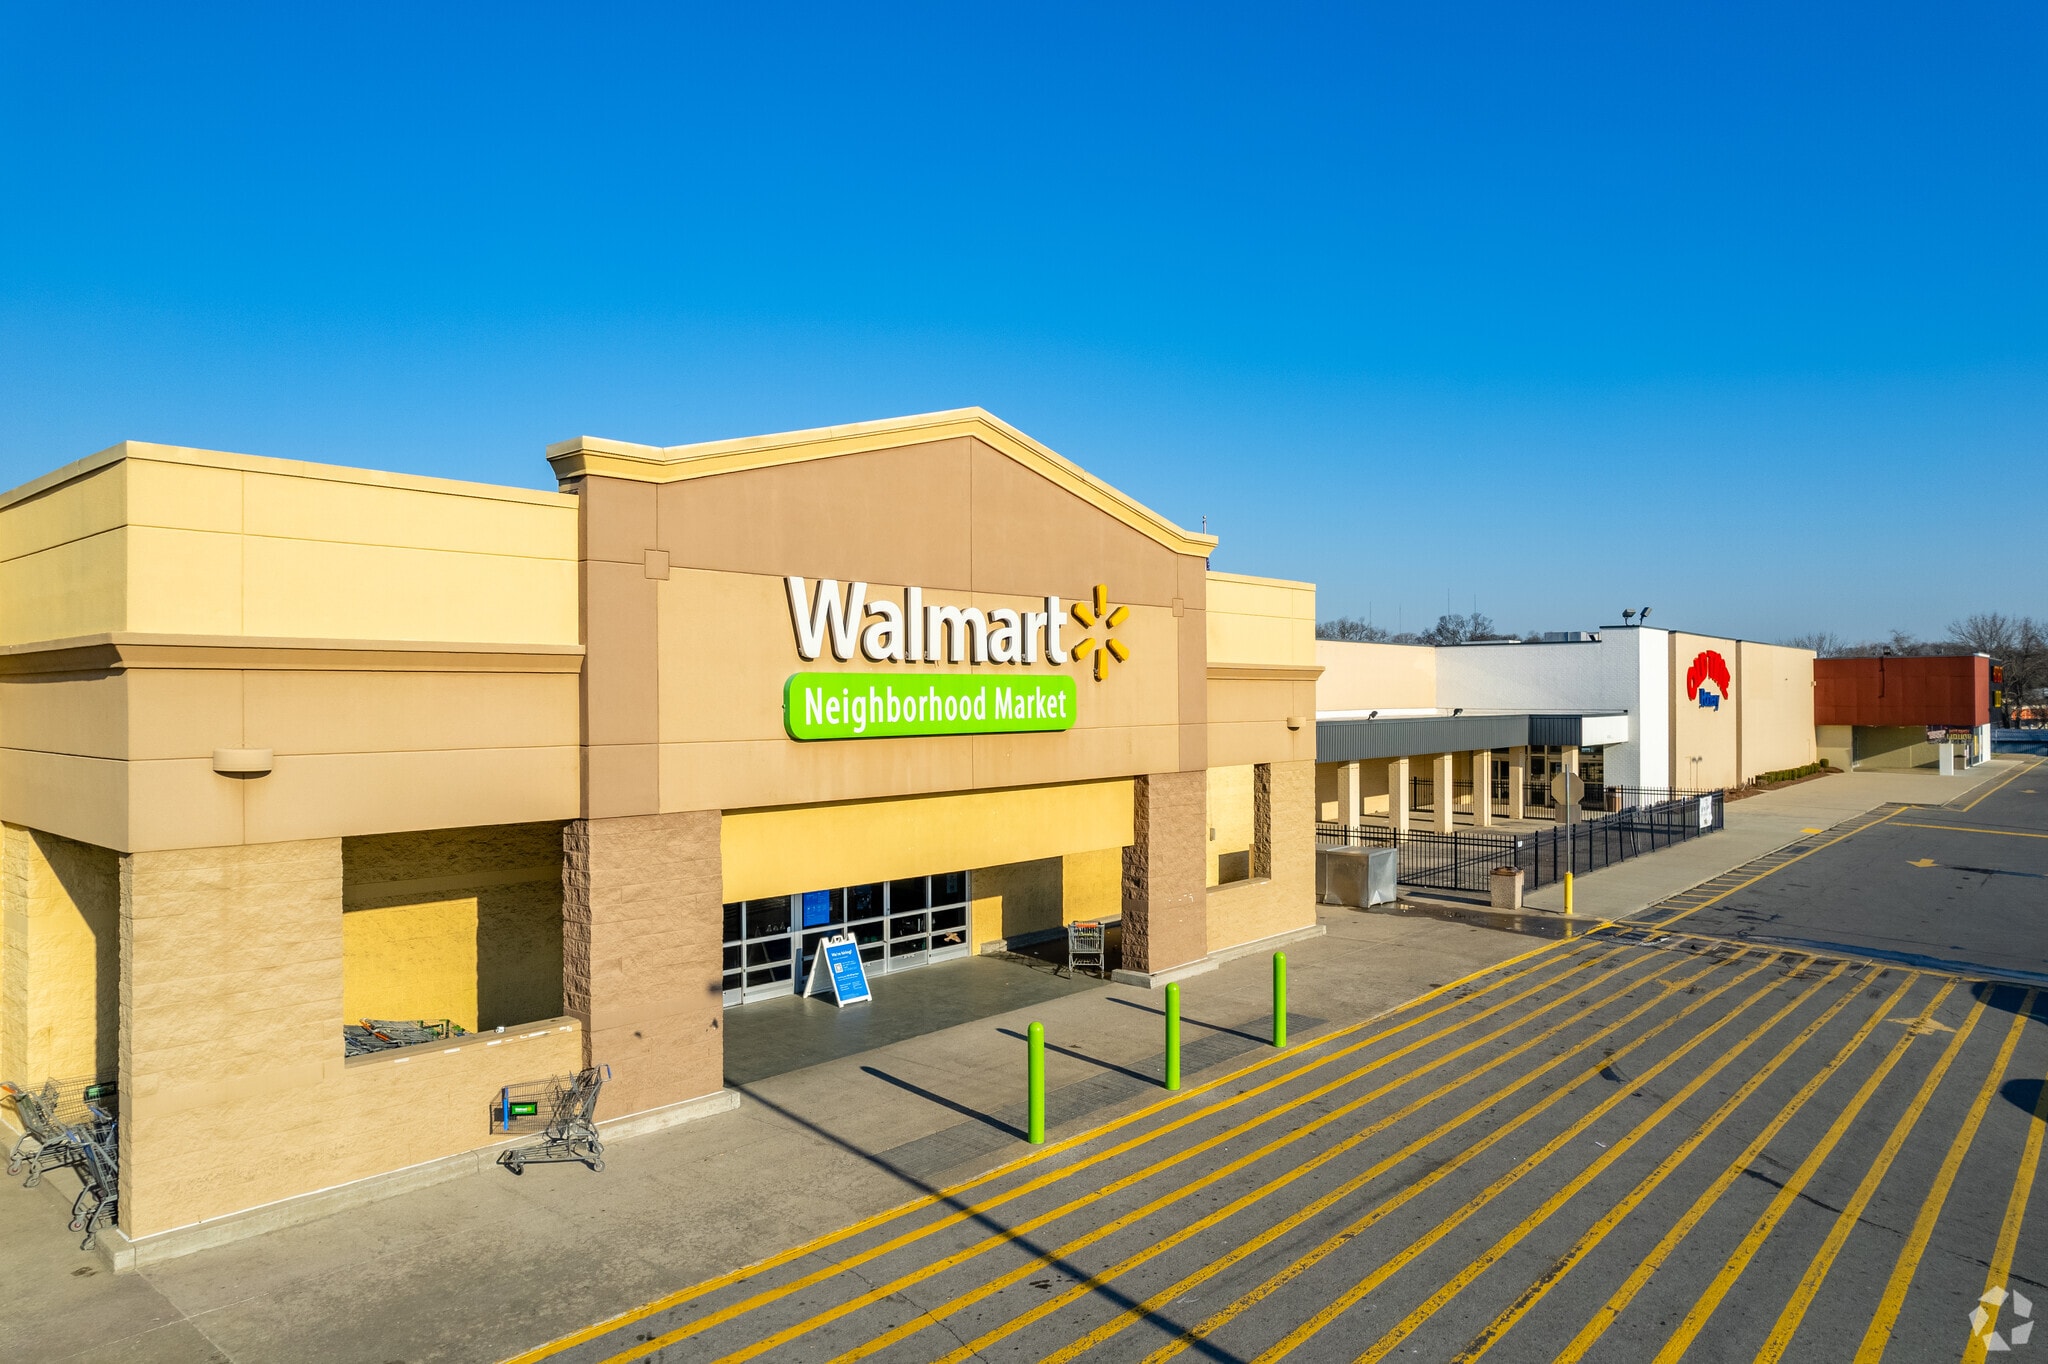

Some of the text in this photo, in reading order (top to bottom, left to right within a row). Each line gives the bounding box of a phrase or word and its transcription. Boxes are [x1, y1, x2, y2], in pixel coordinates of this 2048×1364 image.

[785, 576, 1067, 664] Walmart
[805, 686, 1067, 733] Neighborhood Market
